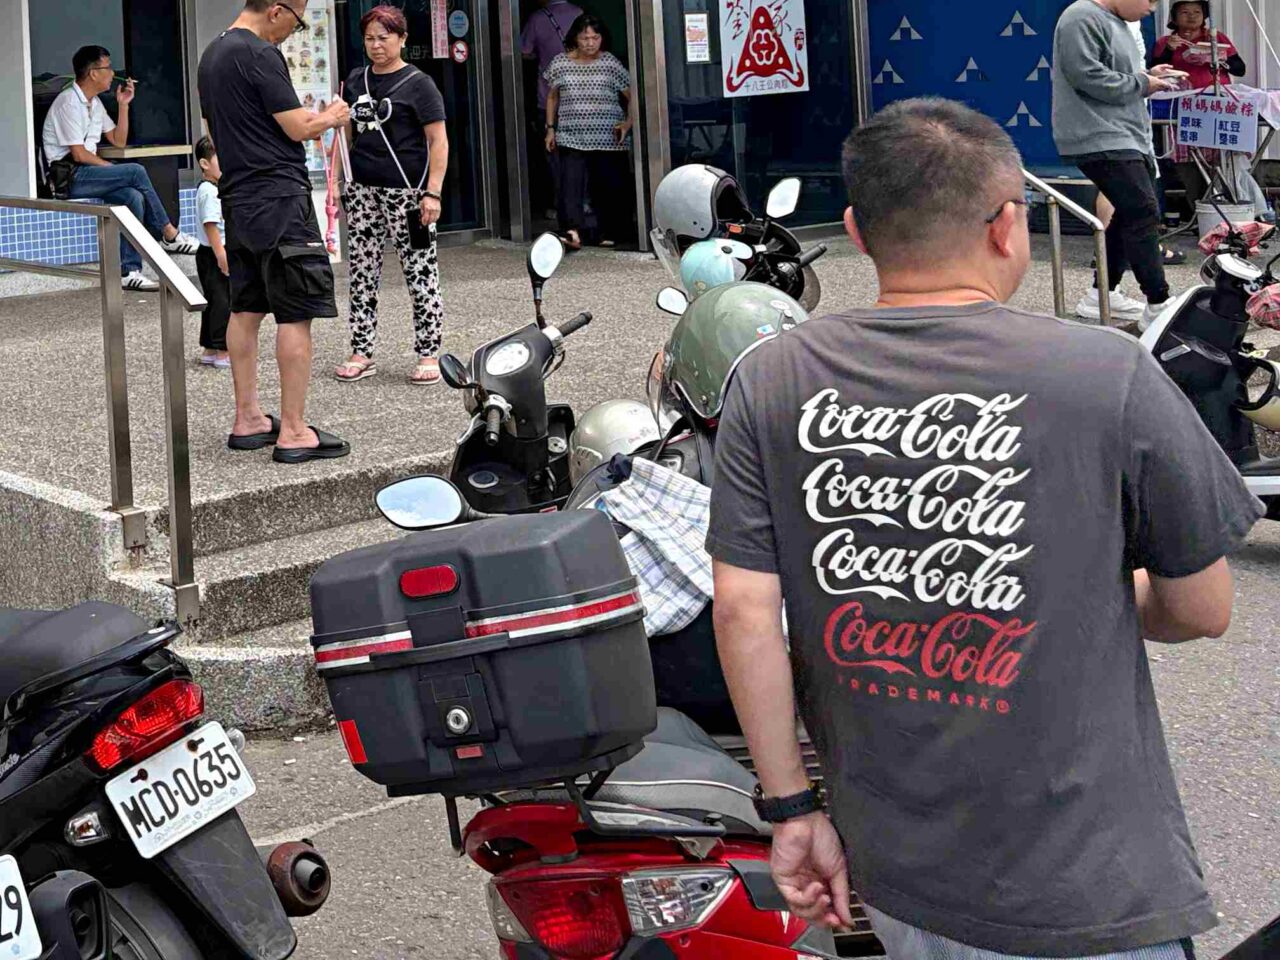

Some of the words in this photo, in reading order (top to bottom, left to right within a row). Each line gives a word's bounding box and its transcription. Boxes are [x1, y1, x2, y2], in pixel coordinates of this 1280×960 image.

[1180, 116, 1201, 128] 原味
[1218, 120, 1240, 132] 紅豆
[120, 742, 241, 839] MCD-0635
